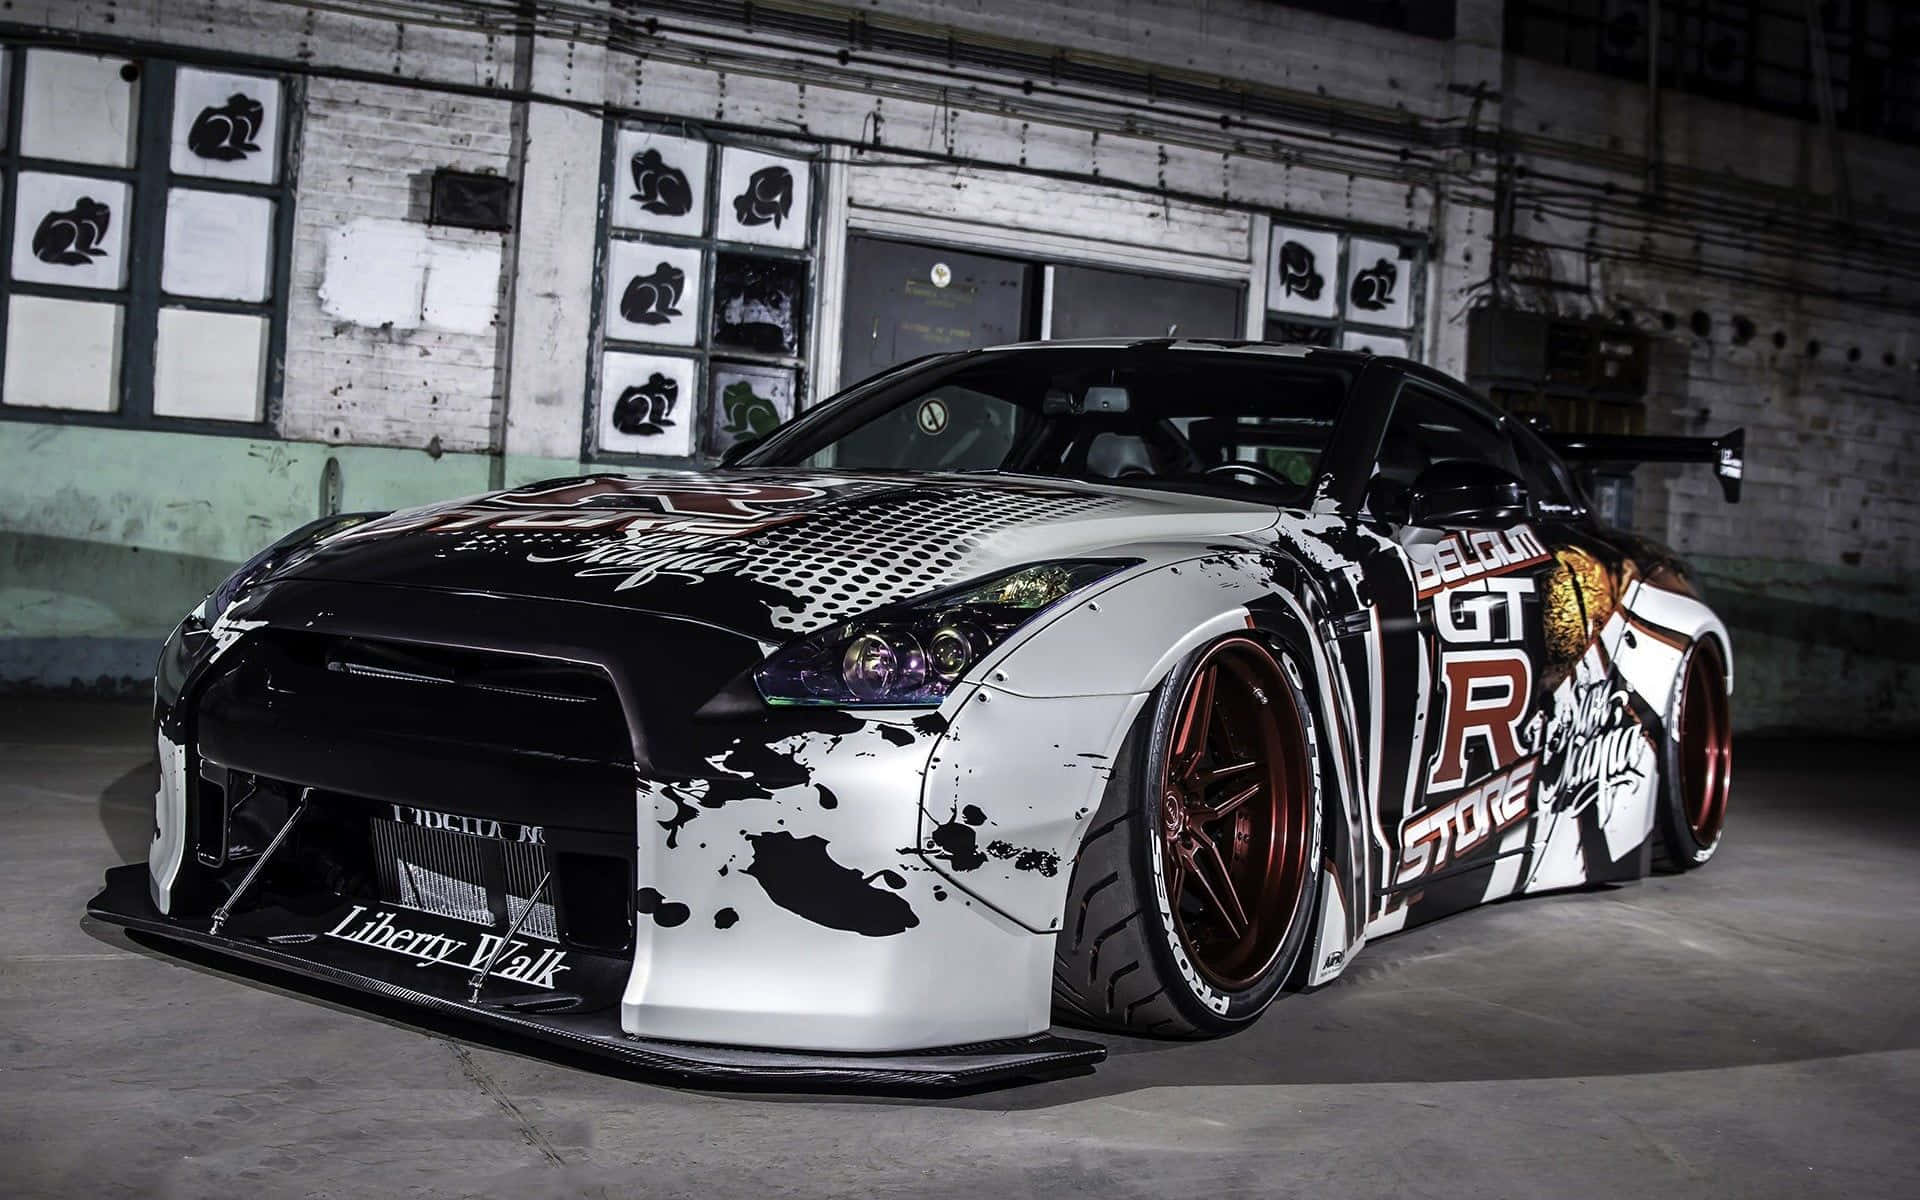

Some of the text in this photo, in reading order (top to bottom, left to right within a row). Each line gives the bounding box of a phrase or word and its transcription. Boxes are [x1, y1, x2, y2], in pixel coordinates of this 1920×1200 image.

[1433, 577, 1537, 643] GT
[1425, 648, 1532, 795] R
[1399, 759, 1541, 884] STORE
[325, 905, 571, 989] Liberty Walk
[1150, 828, 1230, 1016] PROXES
